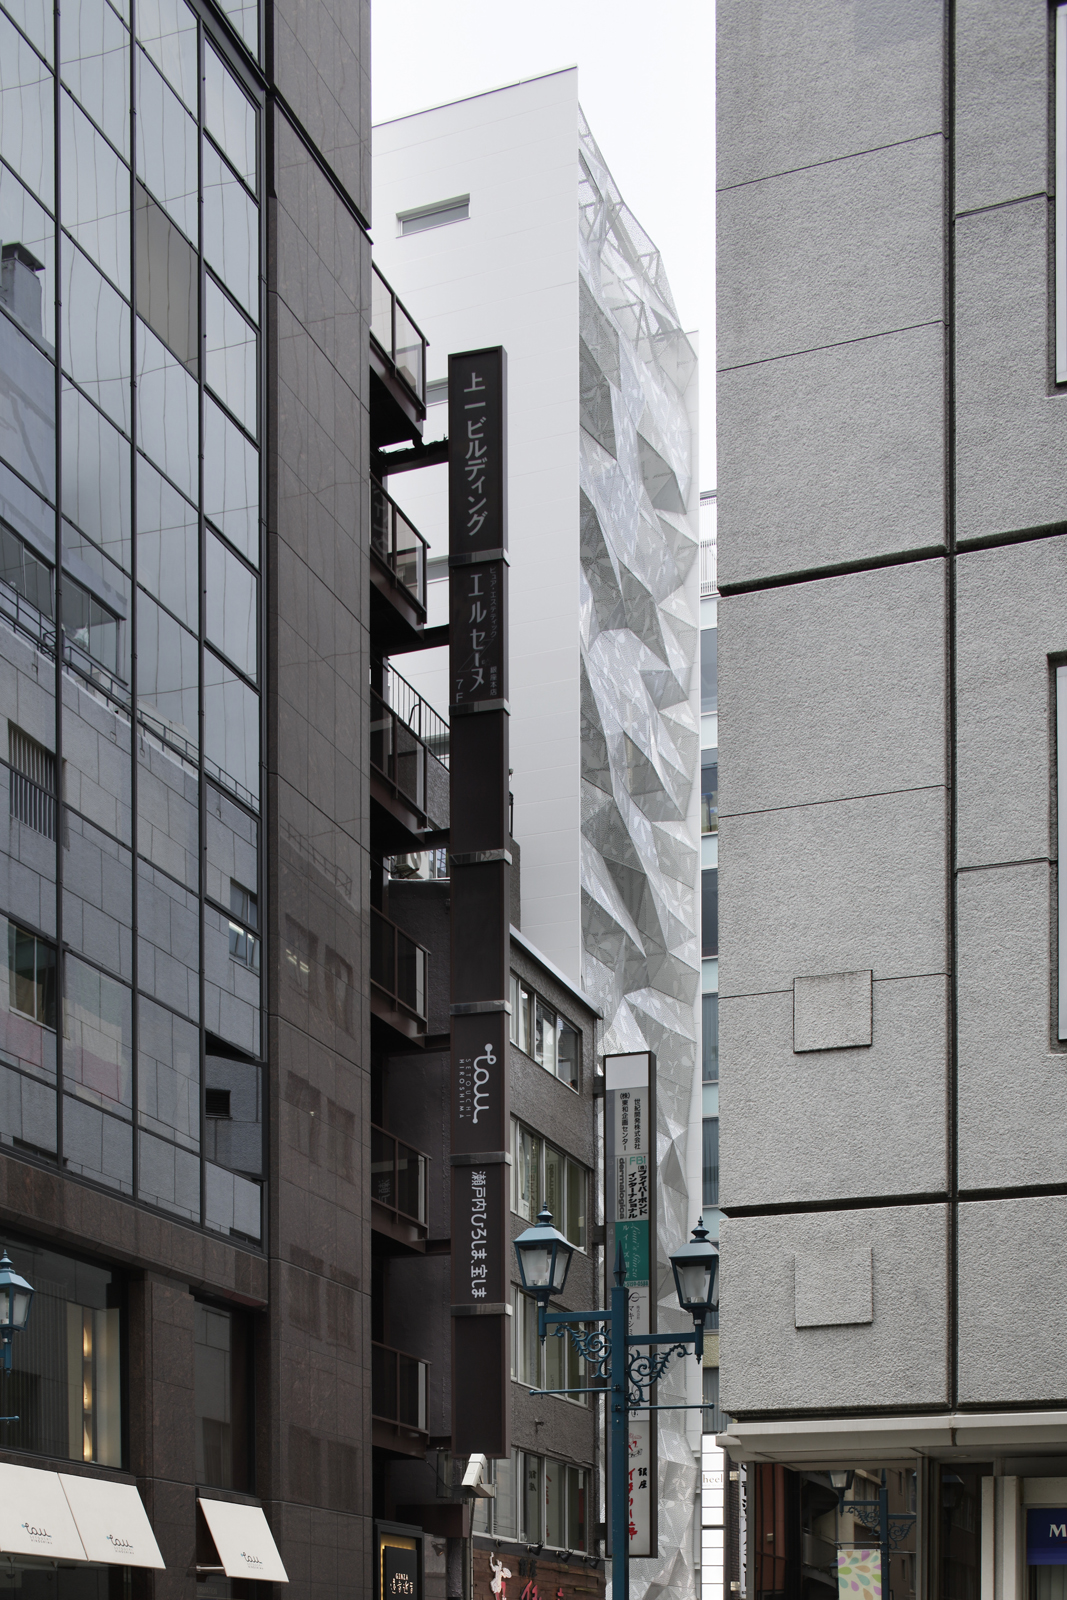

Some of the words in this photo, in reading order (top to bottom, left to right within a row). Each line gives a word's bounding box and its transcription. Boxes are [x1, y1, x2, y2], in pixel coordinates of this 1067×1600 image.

[463, 372, 488, 536] 上一ビルディング
[468, 573, 487, 692] エルセーヌ
[471, 1170, 487, 1298] 瀬戸内ひろしま、宝しま
[628, 1172, 638, 1219] インターナショナル
[637, 1467, 648, 1489] 銀座
